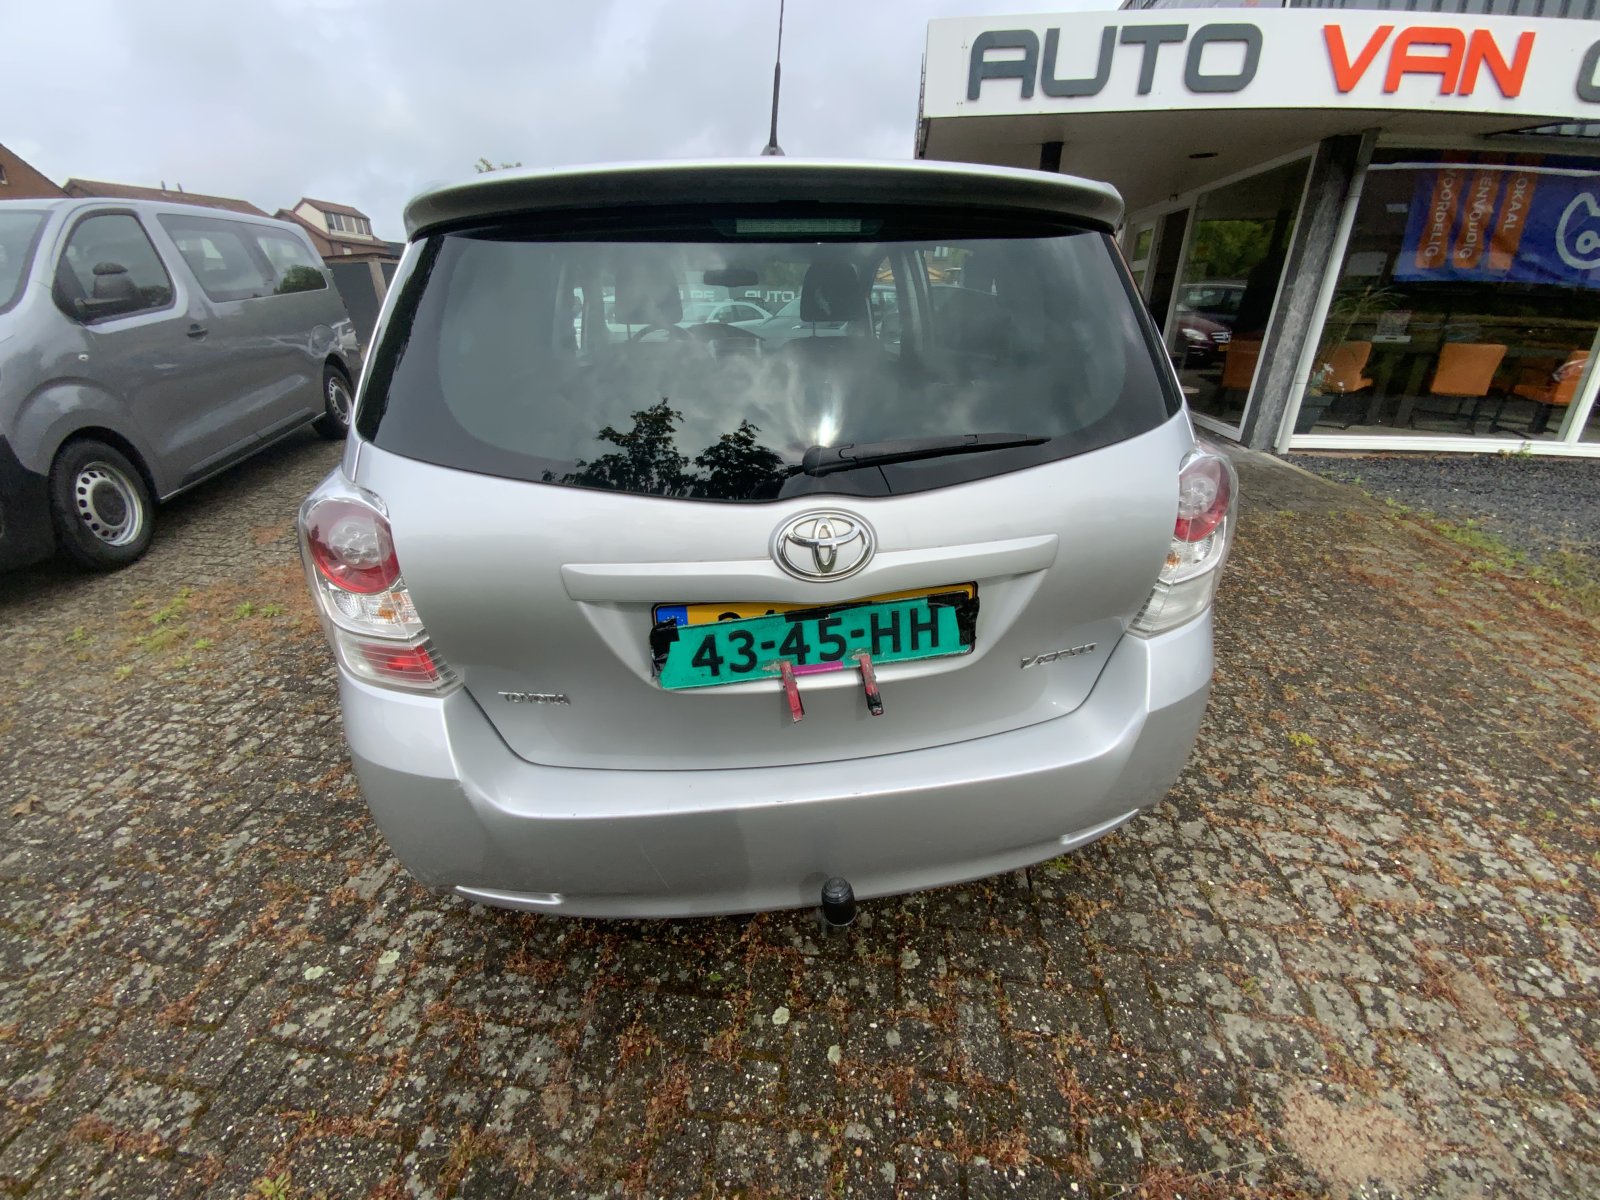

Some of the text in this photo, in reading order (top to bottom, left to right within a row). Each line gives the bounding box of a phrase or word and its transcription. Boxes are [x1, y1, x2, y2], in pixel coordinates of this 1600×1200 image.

[967, 23, 1263, 100] AUTO
[1323, 25, 1536, 98] VAN
[1503, 172, 1529, 231] OKAAL
[691, 606, 939, 677] 43-45-HH
